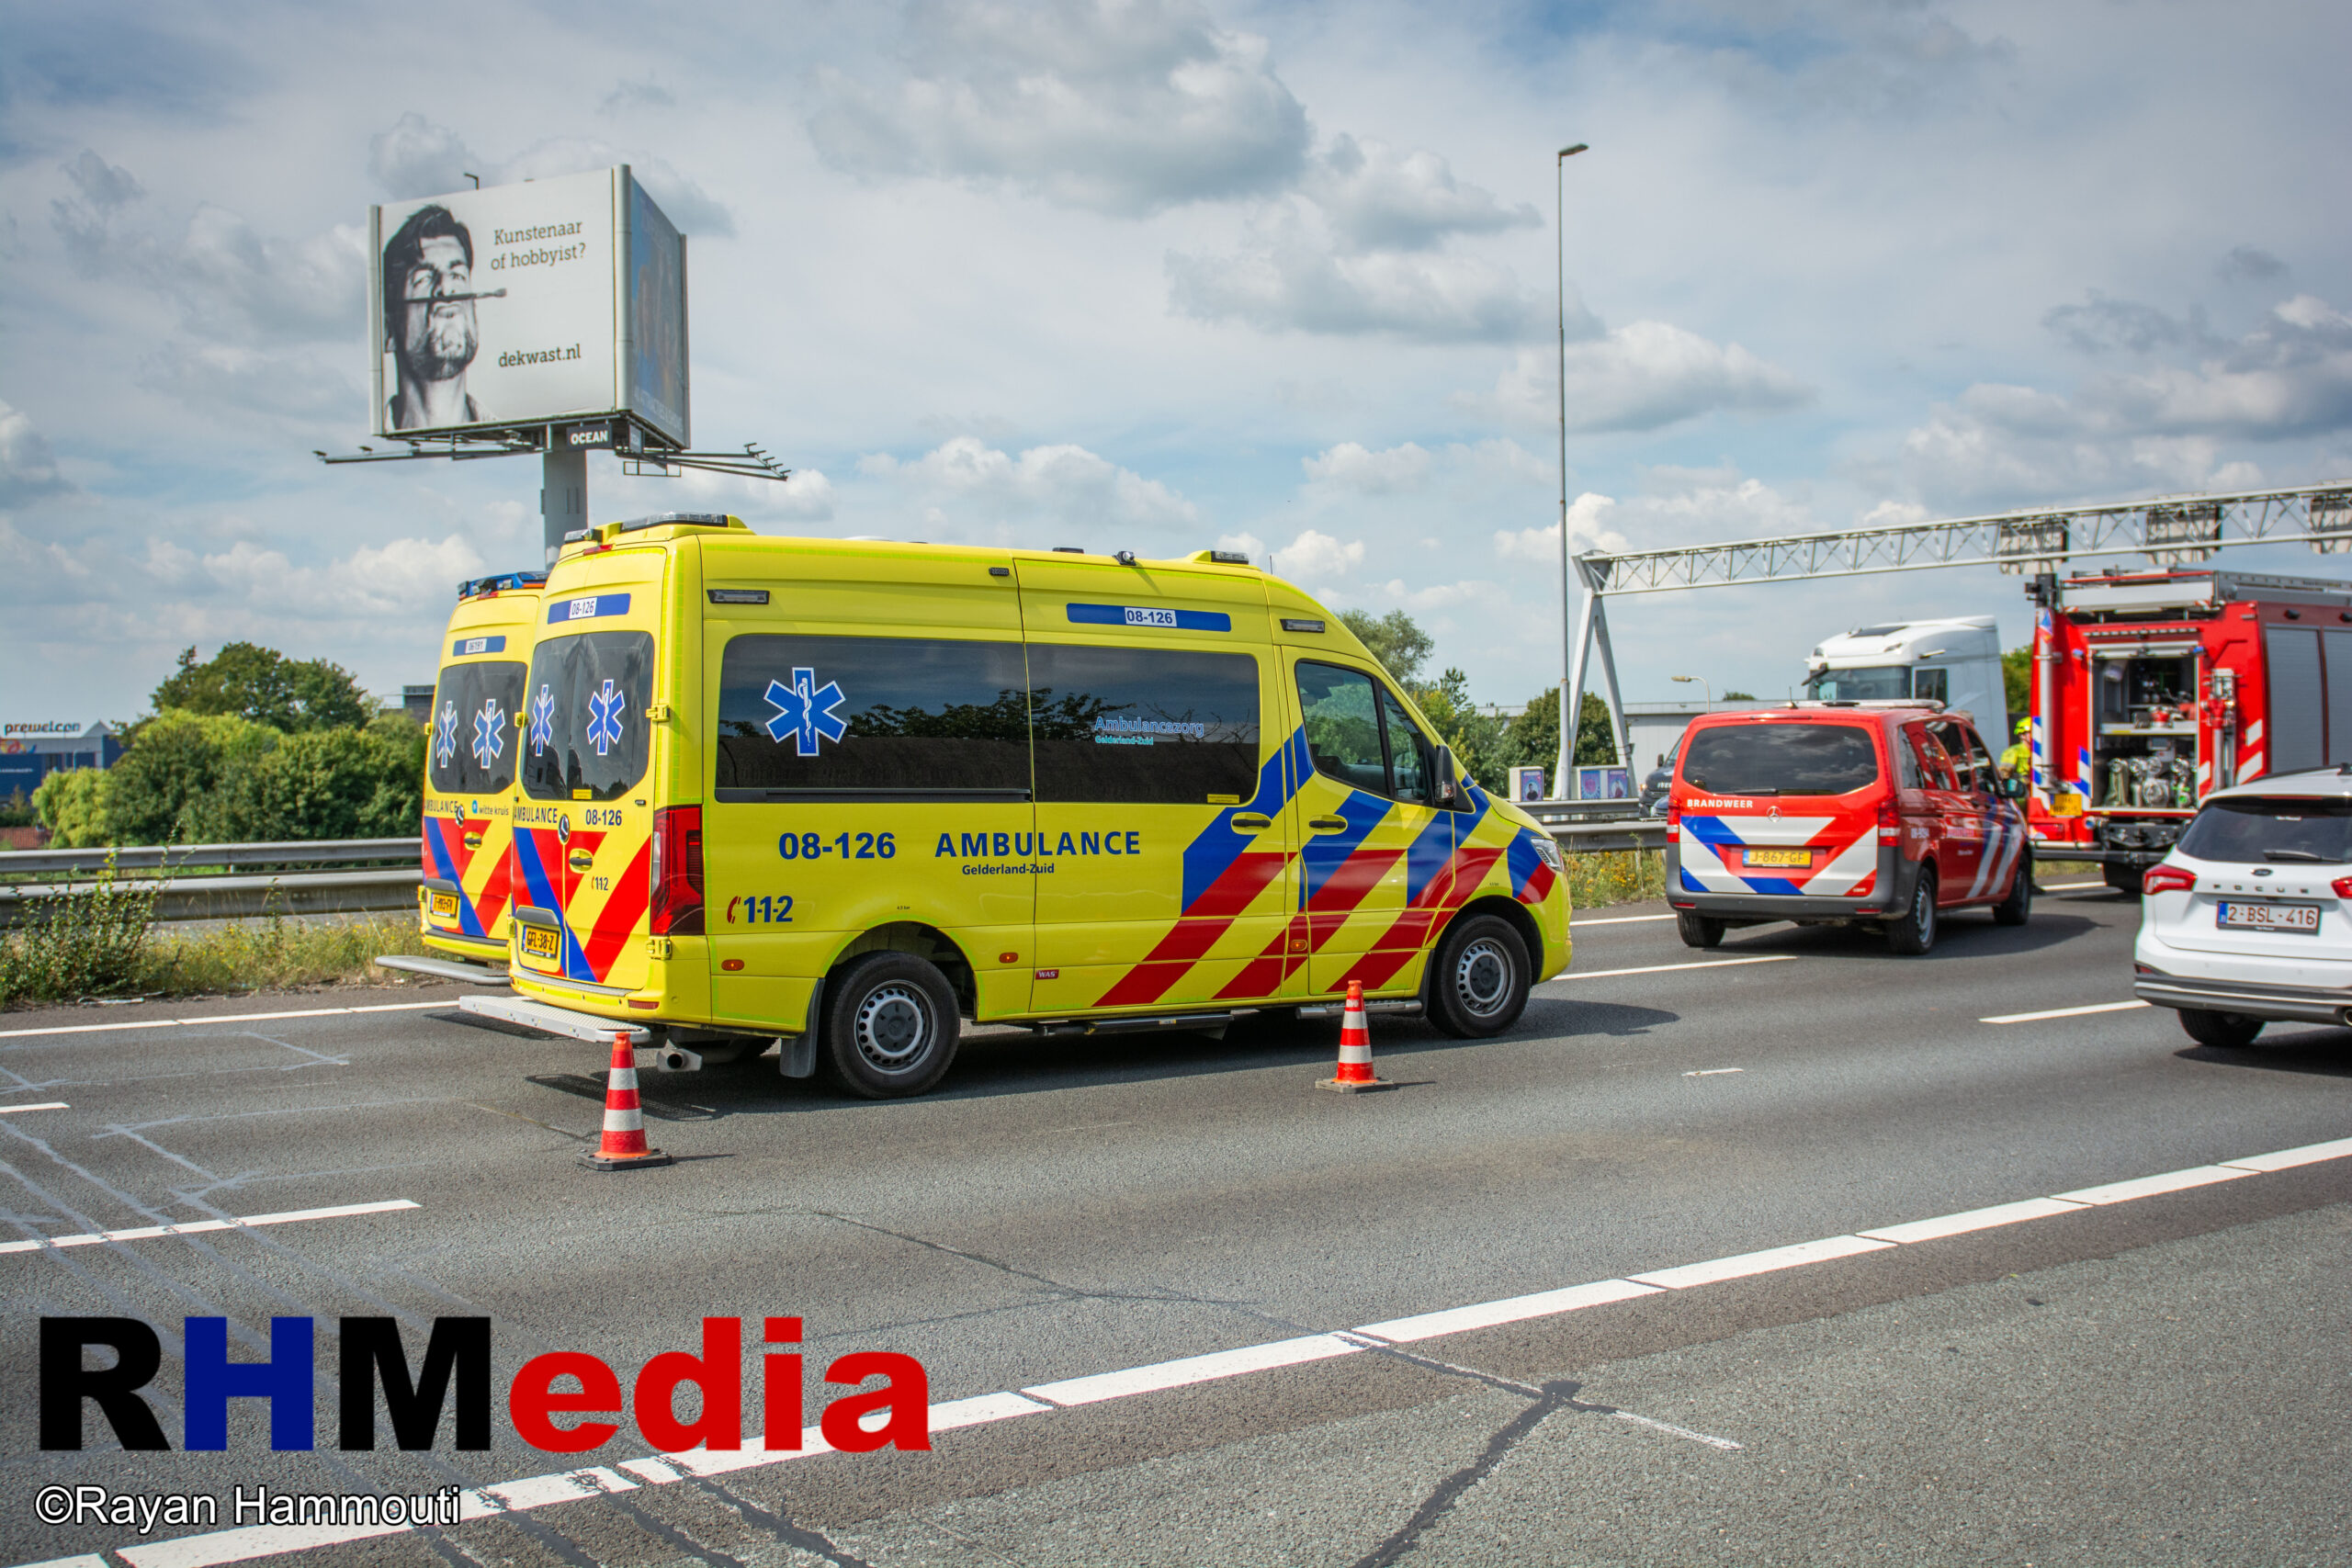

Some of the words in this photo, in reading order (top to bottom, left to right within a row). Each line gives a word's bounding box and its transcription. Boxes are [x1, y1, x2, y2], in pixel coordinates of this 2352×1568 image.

[493, 220, 582, 246] Kunstenaar
[491, 253, 505, 270] of
[511, 242, 586, 266] hobbyist?
[498, 343, 581, 367] dekwast.nl
[571, 429, 609, 445] OCEAN
[571, 600, 595, 615] 08-126
[1126, 610, 1173, 624] 08-126
[1094, 716, 1204, 738] Ambulancezorg
[1095, 735, 1154, 746] Gelderland-Zuid
[494, 805, 509, 816] kruis
[1687, 799, 1753, 808] BRANDWEER
[514, 806, 558, 824] AMBULANCE
[585, 808, 623, 826] 08-126
[778, 831, 897, 860] 08-126
[934, 831, 1140, 858] AMBULANCE
[1751, 851, 1805, 863] J-867-GF
[962, 863, 1055, 875] Gelderland-Zuid
[743, 895, 794, 923] 1-1-2
